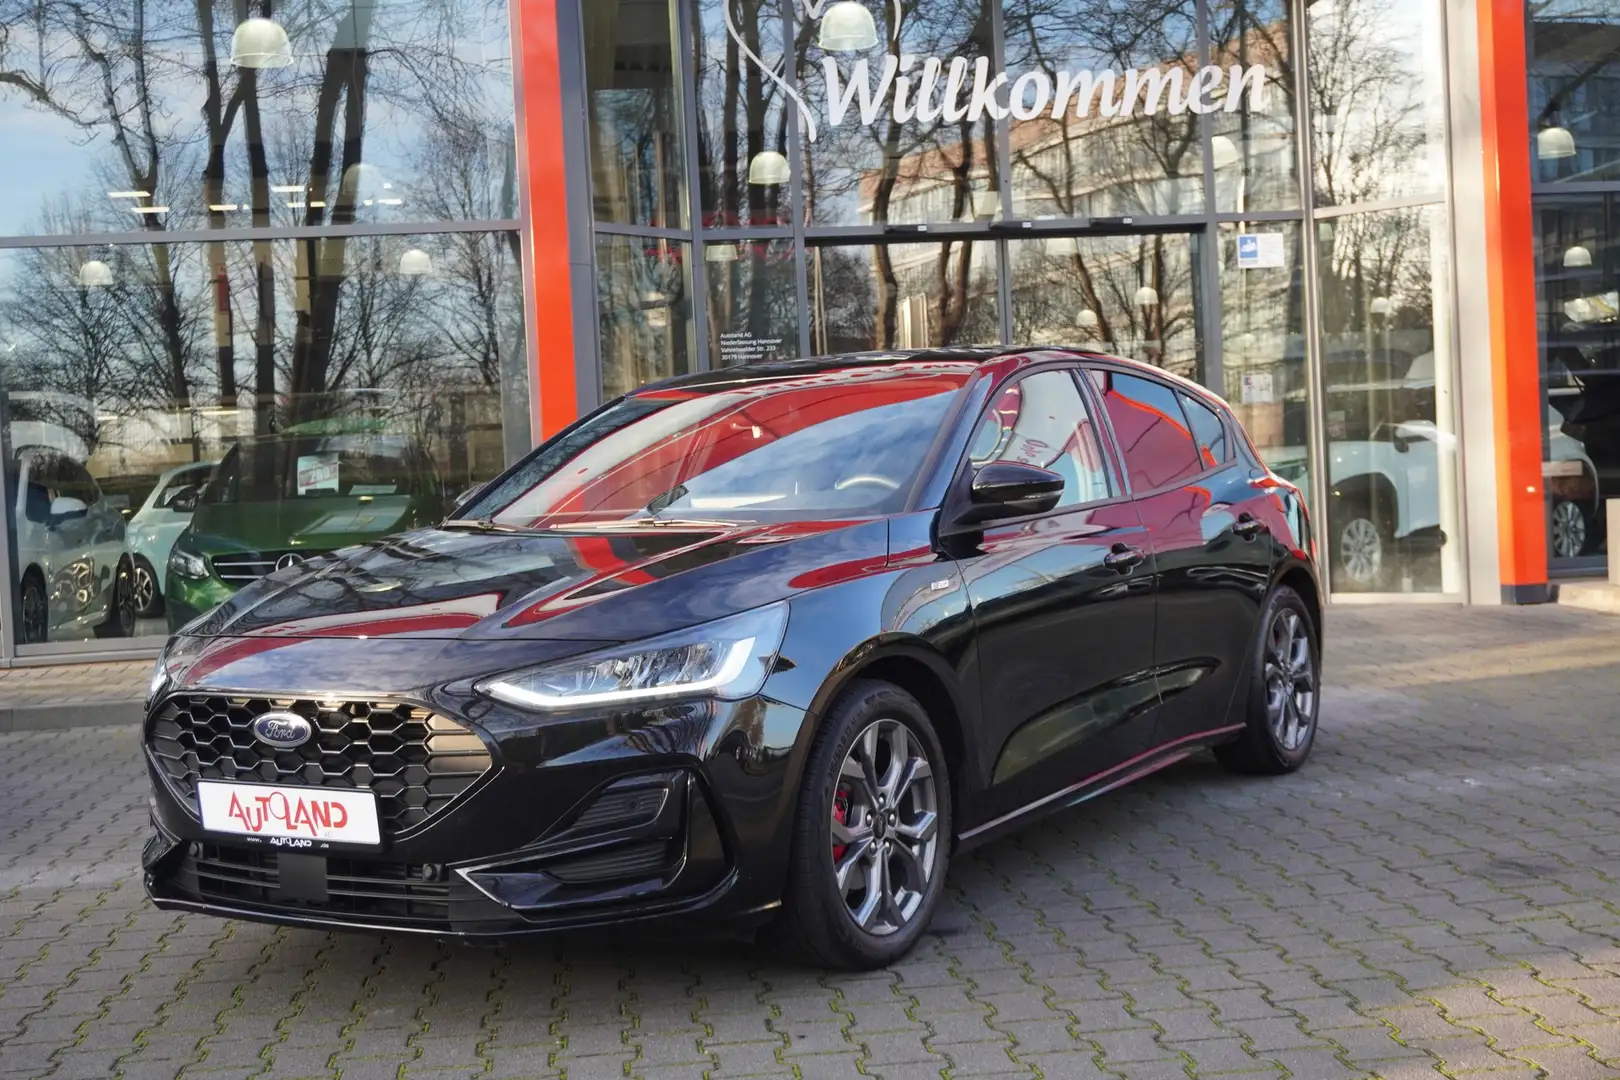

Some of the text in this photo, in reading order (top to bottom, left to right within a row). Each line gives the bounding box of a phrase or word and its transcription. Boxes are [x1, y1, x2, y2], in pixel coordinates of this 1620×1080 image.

[823, 55, 1271, 125] Willkommen
[265, 720, 295, 739] Ford
[228, 790, 348, 837] AUTOLAND
[269, 836, 312, 848] AUTOLAND
